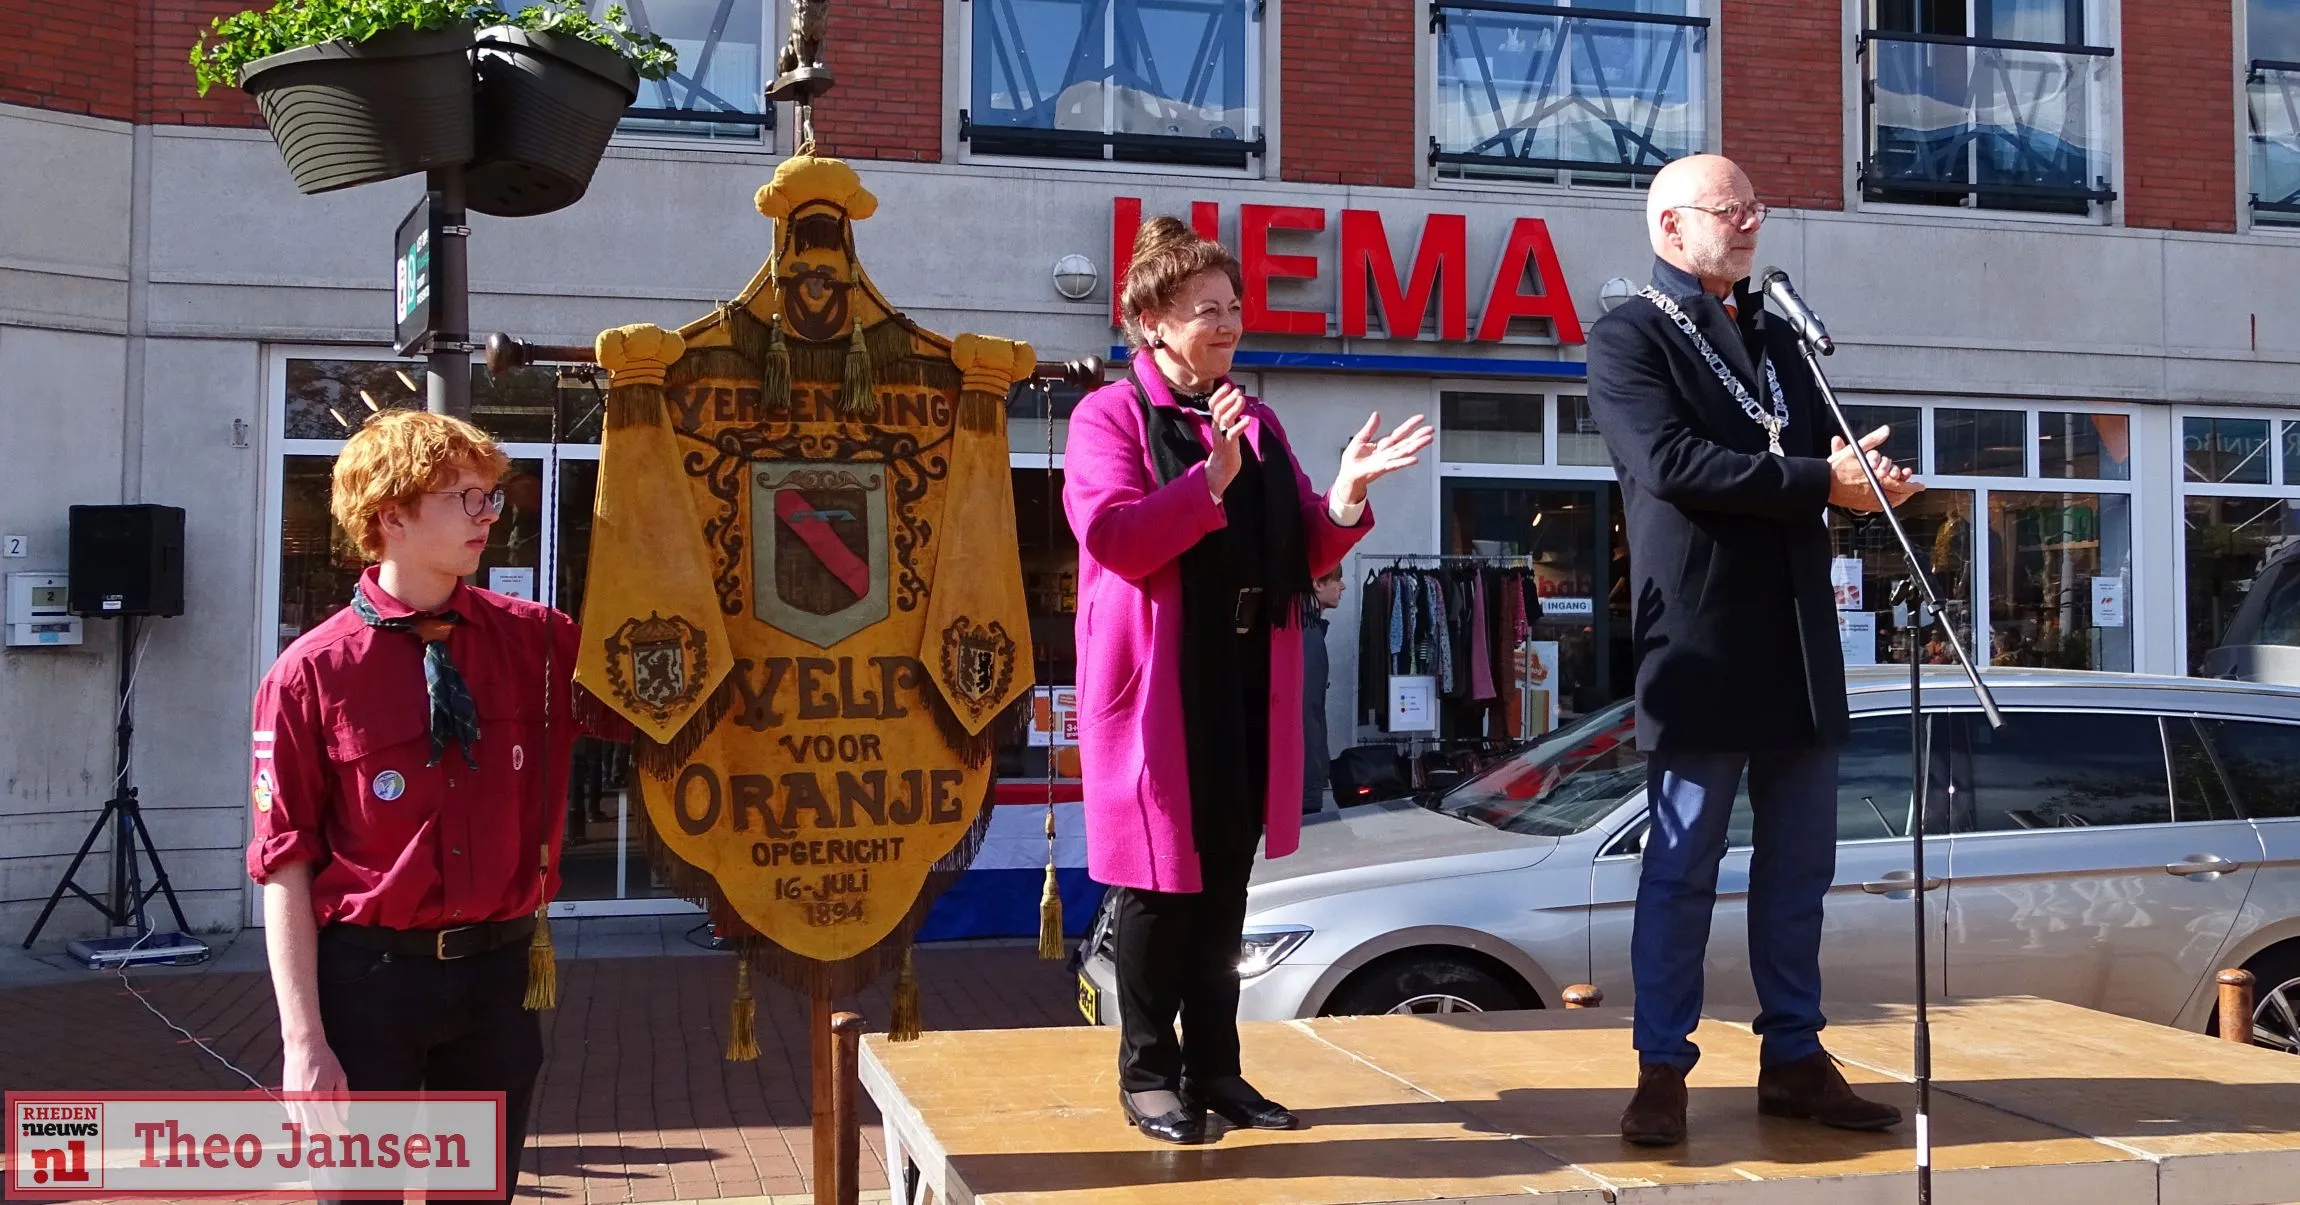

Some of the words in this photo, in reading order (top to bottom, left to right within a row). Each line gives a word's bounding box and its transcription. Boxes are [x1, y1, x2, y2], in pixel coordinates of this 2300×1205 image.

[11, 538, 20, 554] 2
[47, 591, 55, 601] 2
[1547, 601, 1587, 610] INGANG
[732, 656, 921, 731] VELP
[778, 734, 883, 763] VOOR
[674, 763, 964, 839] ORANJE
[751, 837, 904, 867] OPGERICHT
[805, 901, 864, 925] 1894
